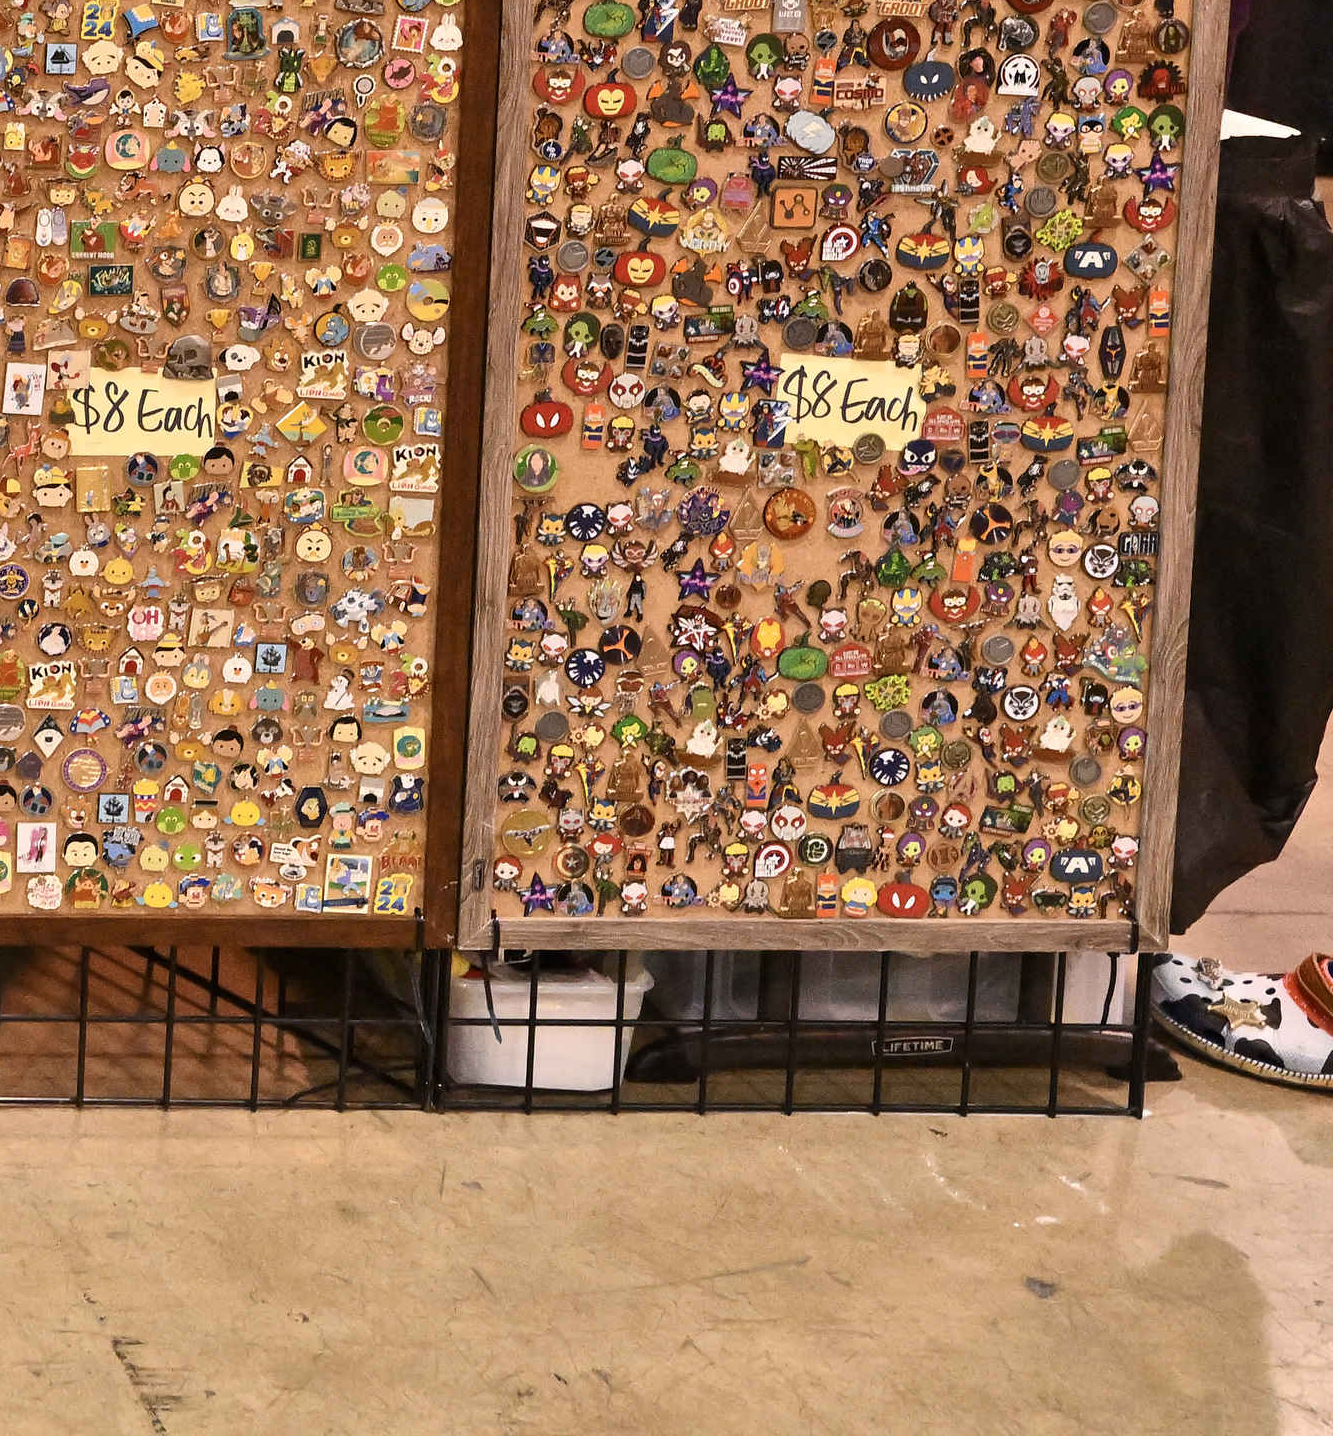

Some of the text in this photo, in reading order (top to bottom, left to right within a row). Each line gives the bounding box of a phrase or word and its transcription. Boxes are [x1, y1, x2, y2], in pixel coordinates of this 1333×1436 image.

[882, 0, 928, 16] GROOT
[836, 86, 885, 99] COSMO
[303, 352, 345, 369] KION
[782, 365, 918, 432] $8 Each
[72, 382, 213, 438] $8 Each
[32, 665, 72, 680] KION
